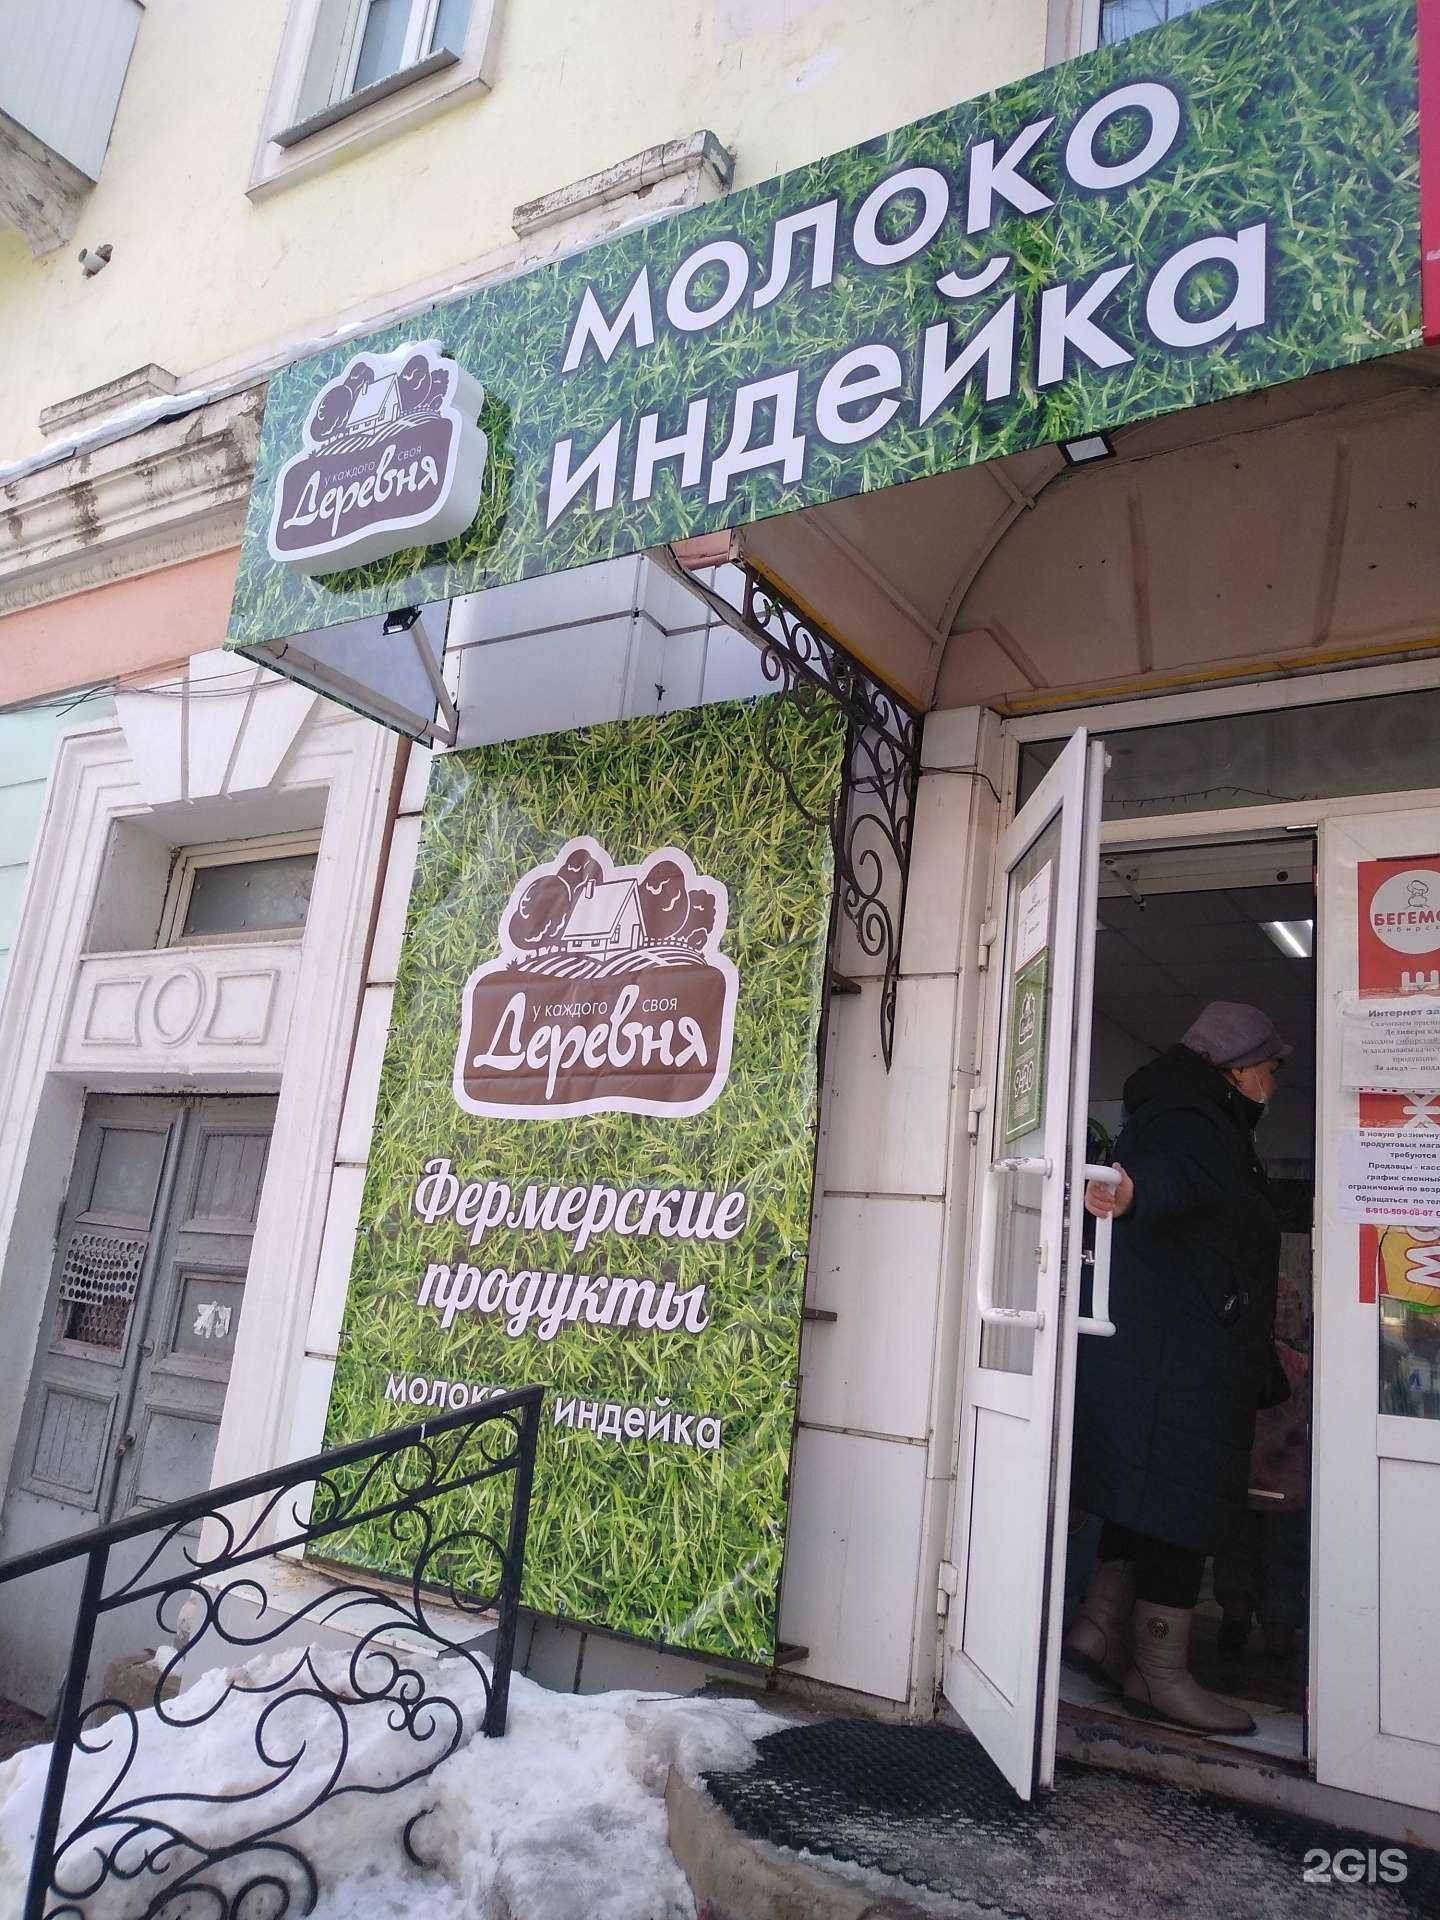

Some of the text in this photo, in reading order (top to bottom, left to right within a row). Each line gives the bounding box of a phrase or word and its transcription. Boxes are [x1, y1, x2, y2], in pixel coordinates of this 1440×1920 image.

[561, 82, 1180, 373] молоко
[545, 223, 1267, 529] индейка
[330, 461, 375, 480] каждого
[397, 445, 422, 461] своя
[283, 444, 438, 537] Деревня
[532, 998, 678, 1023] у каждого своя
[1368, 1009, 1422, 1018] Интернет
[473, 984, 708, 1100] Деревня
[1348, 1184, 1405, 1192] ограничений
[1366, 1174, 1399, 1182] график
[1368, 1162, 1412, 1170] Продавцы
[413, 1158, 746, 1252] Фермерские
[1355, 1195, 1408, 1203] Обращаться
[416, 1263, 709, 1341] продукты
[553, 1397, 722, 1450] индейка
